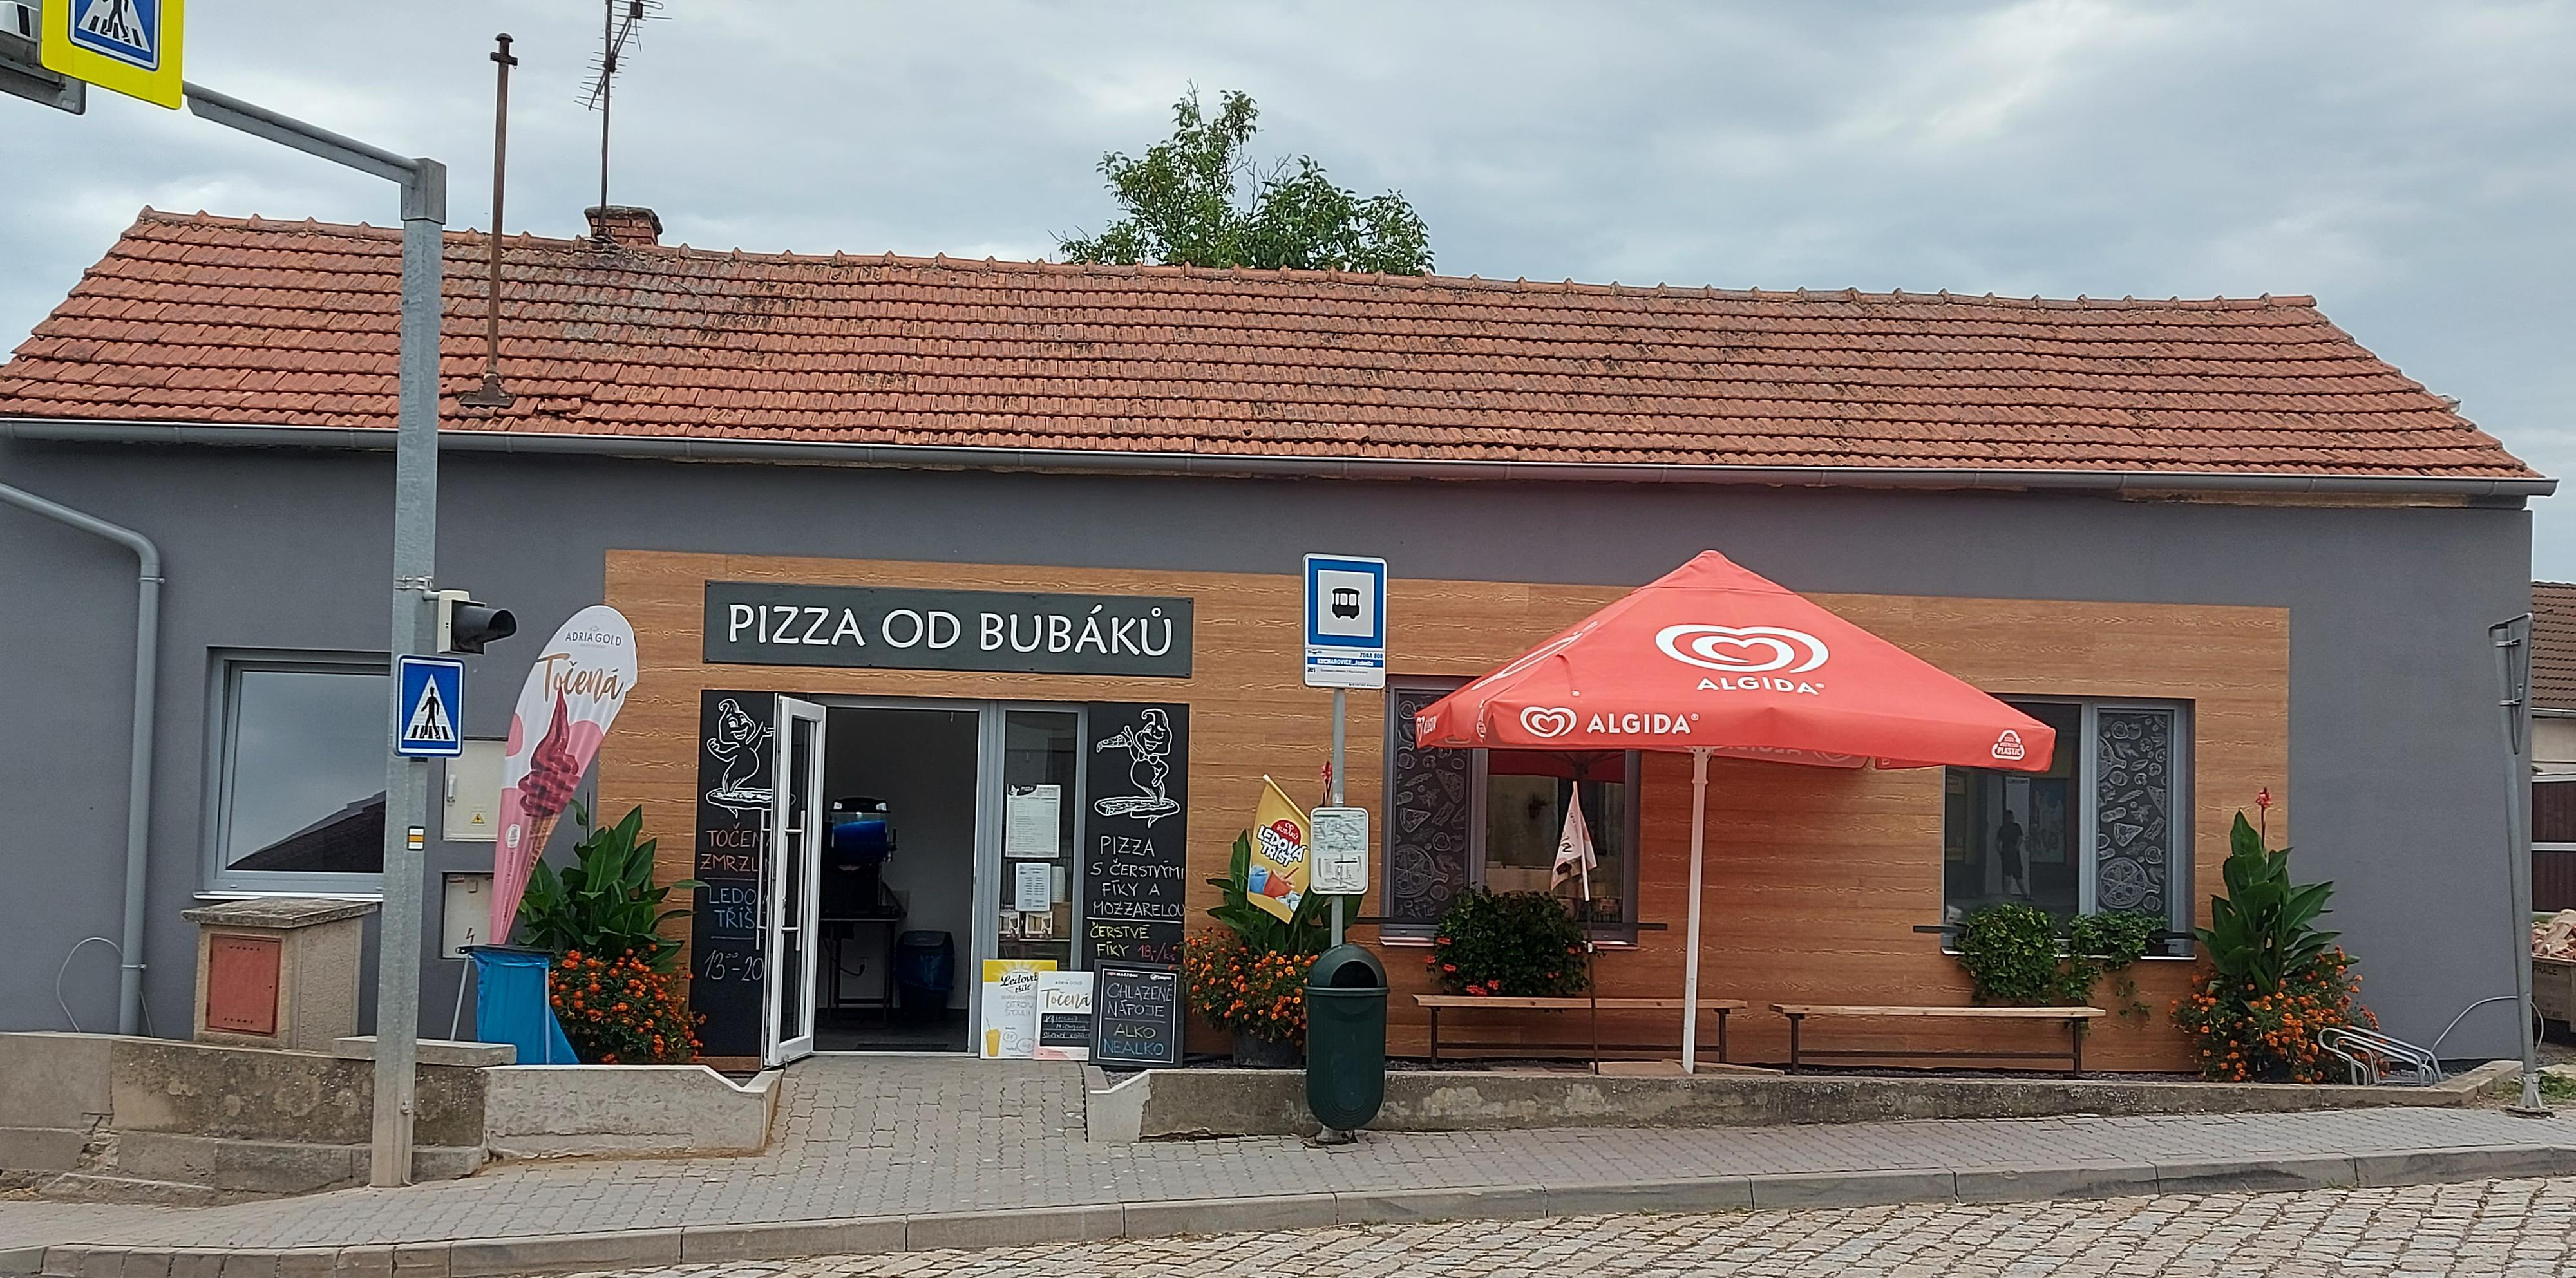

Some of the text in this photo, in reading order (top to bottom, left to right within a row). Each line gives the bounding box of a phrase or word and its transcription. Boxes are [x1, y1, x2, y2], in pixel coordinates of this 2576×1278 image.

[565, 632, 622, 646] ADRIA GOLD
[728, 603, 1173, 657] PIZZA OD BUBÁKŮ
[536, 653, 624, 704] Točená
[1696, 676, 1820, 696] ALGIDA
[1586, 712, 1692, 735] ALGIDA
[1997, 747, 2022, 756] PLASTIC
[705, 822, 760, 848] TOČEN
[1256, 824, 1308, 863] LEDOVÁ
[1100, 836, 1155, 858] PIZZA
[699, 853, 760, 872] ZMRZL
[1090, 861, 1103, 876] S
[708, 888, 757, 905] LEDO
[1102, 879, 1160, 897] FÍKY A
[714, 906, 757, 929] TŘÍŠ
[1093, 901, 1186, 917] MOZZARELOU
[1090, 921, 1151, 939] ČERSTVÉ
[1096, 941, 1130, 957] FÍKY
[1040, 988, 1092, 1010] Točená
[1106, 982, 1173, 1002] CHLAZENÉ
[1107, 999, 1165, 1017] NÁPOJE
[1113, 1022, 1157, 1039] ALKO
[1103, 1038, 1165, 1056] NEALKO
